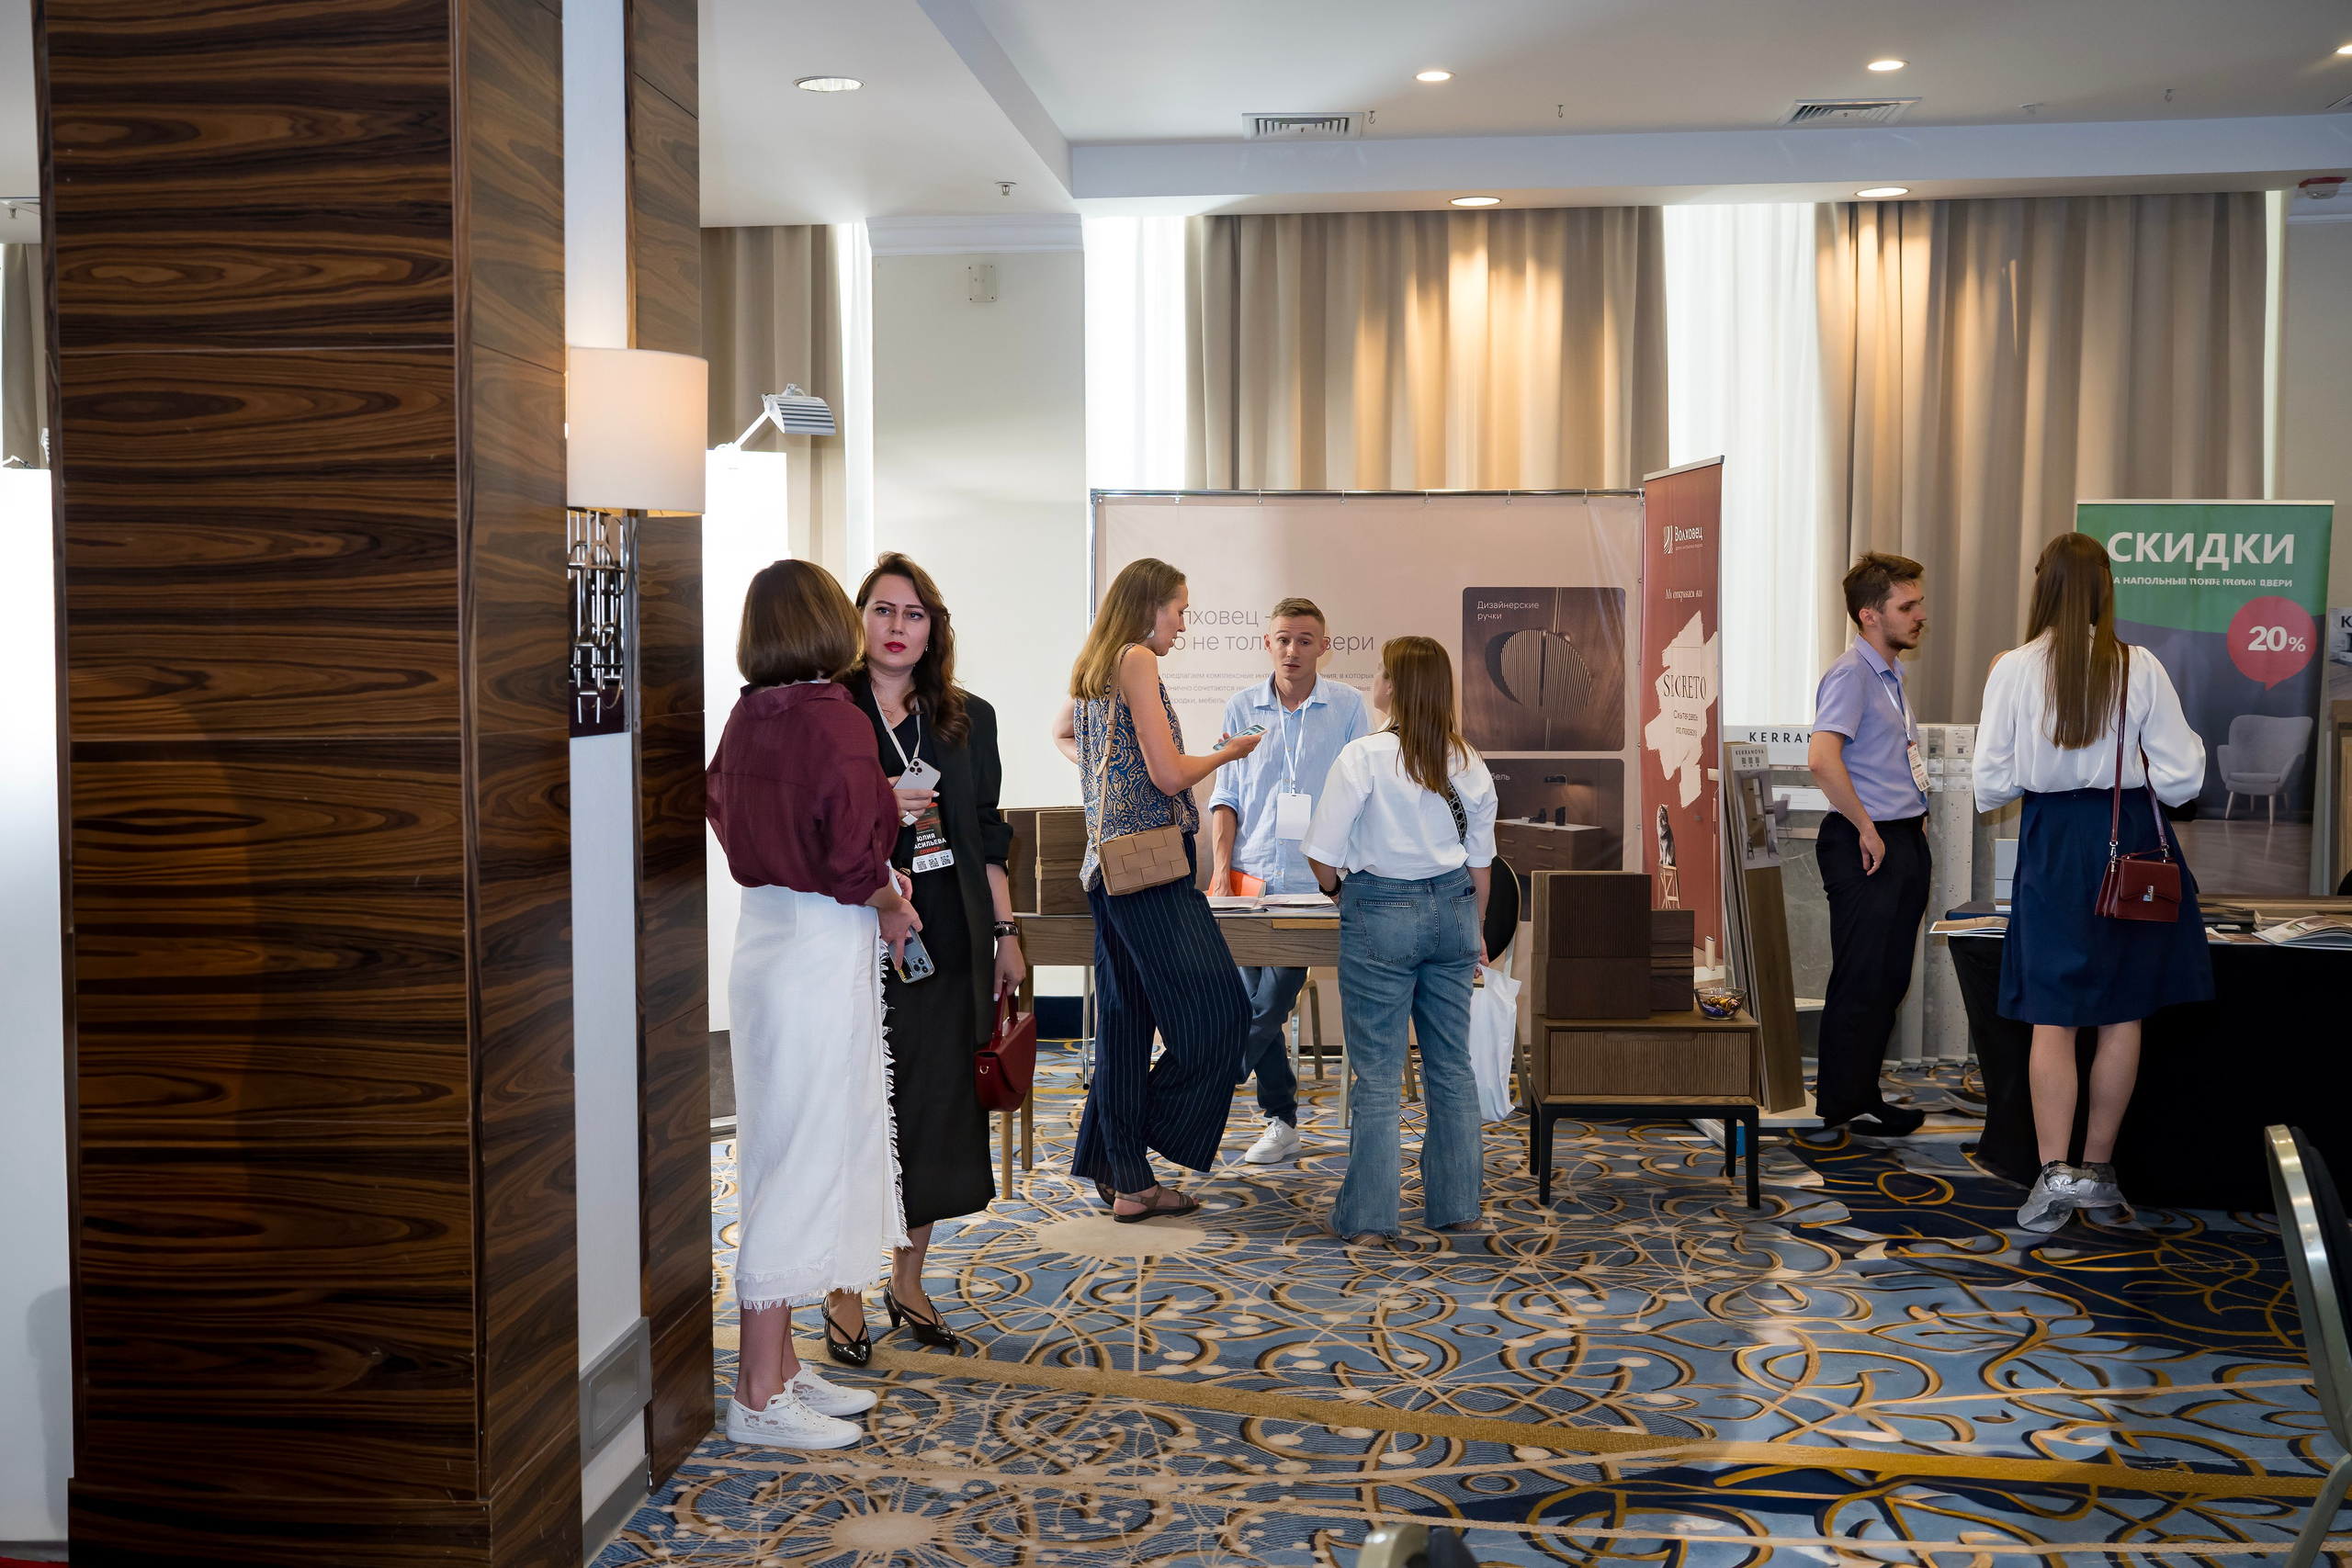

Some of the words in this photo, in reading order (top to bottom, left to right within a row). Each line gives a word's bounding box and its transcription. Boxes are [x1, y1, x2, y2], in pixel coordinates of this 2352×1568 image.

[2107, 531, 2295, 571] СКИДКИ
[1476, 601, 1540, 610] Дизайнерские
[1477, 613, 1502, 622] ручки
[1193, 636, 1219, 650] не
[1224, 636, 1267, 650] тол
[2247, 626, 2306, 652] 20%
[1345, 672, 1375, 681] которых
[916, 832, 936, 842] ЮЛИЯ
[914, 837, 947, 850] АСИЛЬЕВА
